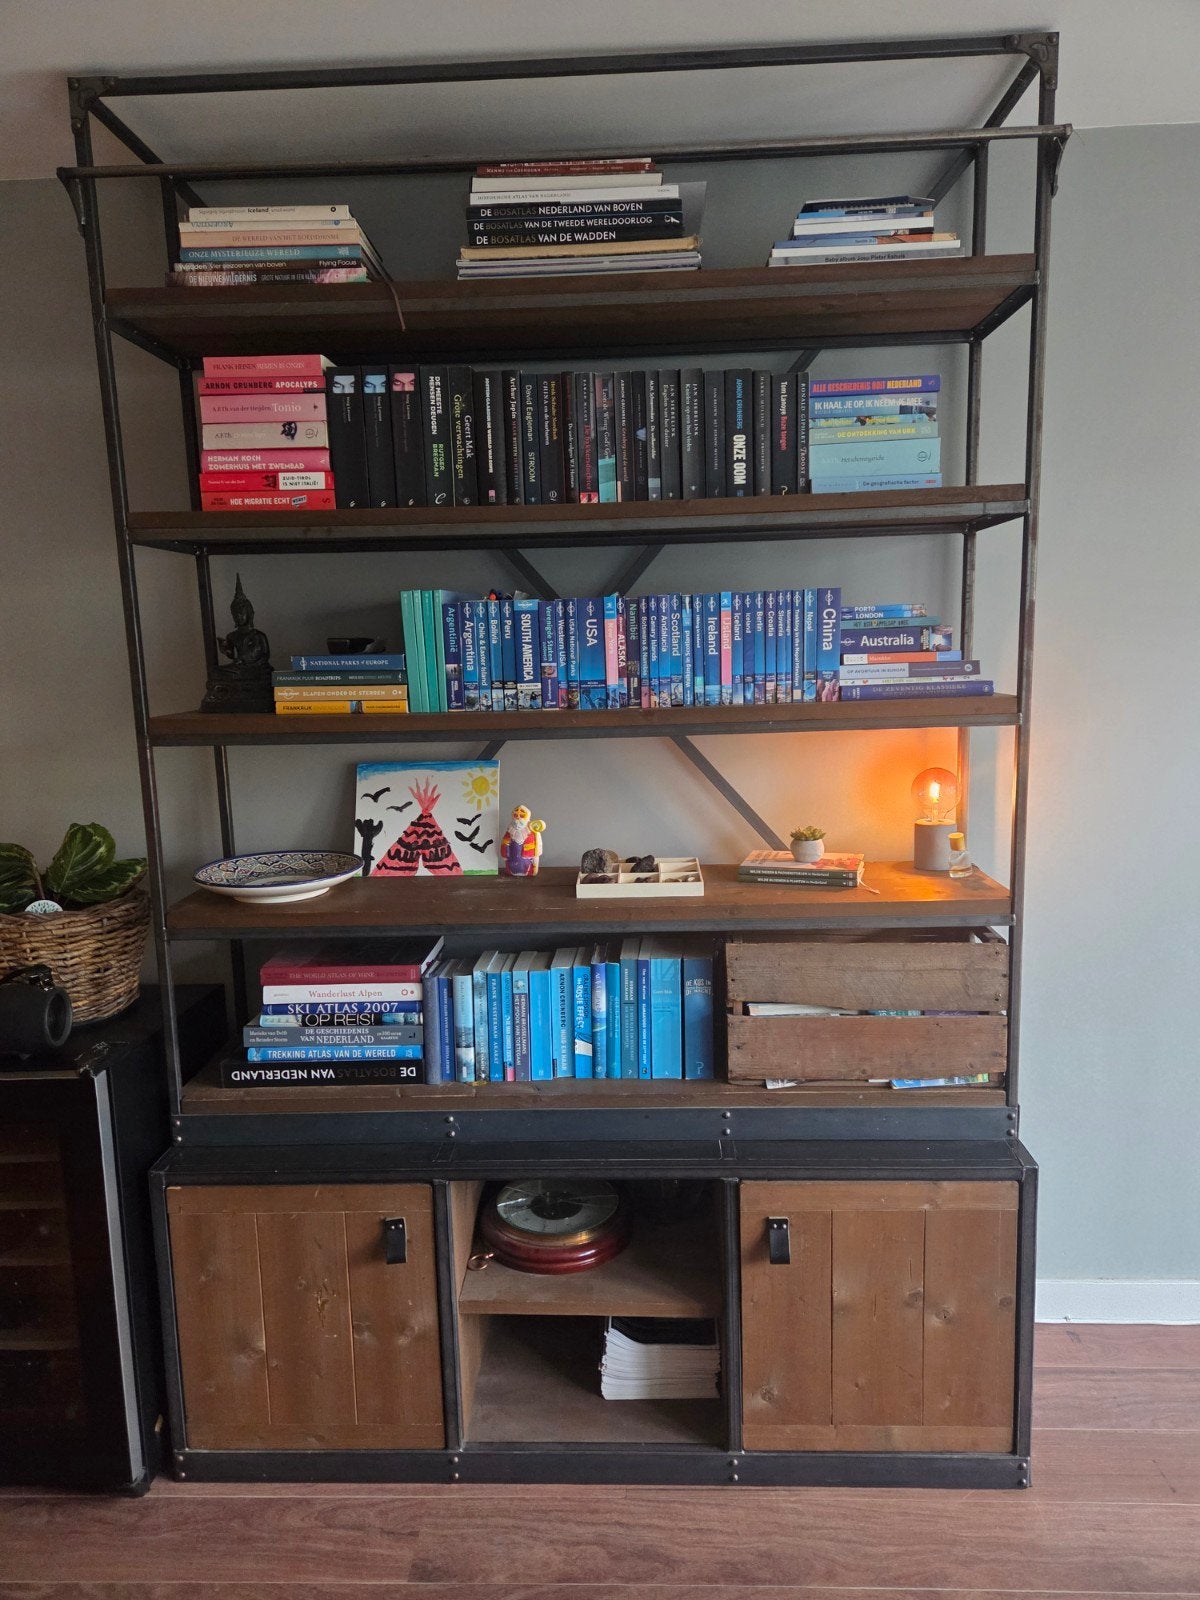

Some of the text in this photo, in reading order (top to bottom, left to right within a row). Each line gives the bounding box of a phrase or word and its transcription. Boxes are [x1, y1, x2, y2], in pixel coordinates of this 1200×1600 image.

[474, 222, 484, 230] DE
[486, 221, 523, 229] BOSATLAS
[541, 220, 552, 228] DE
[554, 219, 585, 227] TWEEDE
[587, 216, 653, 226] WERELDOORLOG
[480, 203, 643, 217] DE BOSATLAS NEDERLAND VAN BOVEN
[267, 248, 300, 256] WERELD
[476, 231, 616, 244] DE BOSATLAS VAN DE WADDEN
[434, 376, 440, 385] DE
[815, 402, 823, 410] IK
[875, 399, 896, 407] NEEM
[454, 394, 464, 479] Grote verwachtingen
[464, 415, 474, 458] Geert Mak
[525, 406, 534, 441] Eagleman
[733, 434, 747, 485] ONZE OOM
[446, 607, 458, 653] Argentinië
[544, 606, 553, 639] Verenigde
[586, 618, 598, 646] USA
[629, 603, 638, 640] Namibië
[671, 612, 680, 656] Scotland
[707, 617, 718, 655] Ireland
[722, 617, 731, 649] IJsland
[822, 608, 836, 651] China
[463, 620, 474, 671] Argentina
[521, 614, 533, 681] SOUTH AMERICA
[618, 634, 626, 667] ALASKA
[684, 630, 692, 656] Scotland
[860, 634, 914, 647] Australia
[287, 1002, 398, 1014] SKI ATLAS 2007
[308, 989, 383, 998] Wanderlust Alpen
[575, 984, 584, 1028] ROSIE EFFECT
[305, 1013, 375, 1027] OP REIS!
[267, 1049, 396, 1058] TREKKING ATLAS VAN DE WERELD
[316, 1035, 375, 1044] NEDERLAND
[231, 1066, 416, 1081] DE BOSATLAS VAN NEDERLAND
